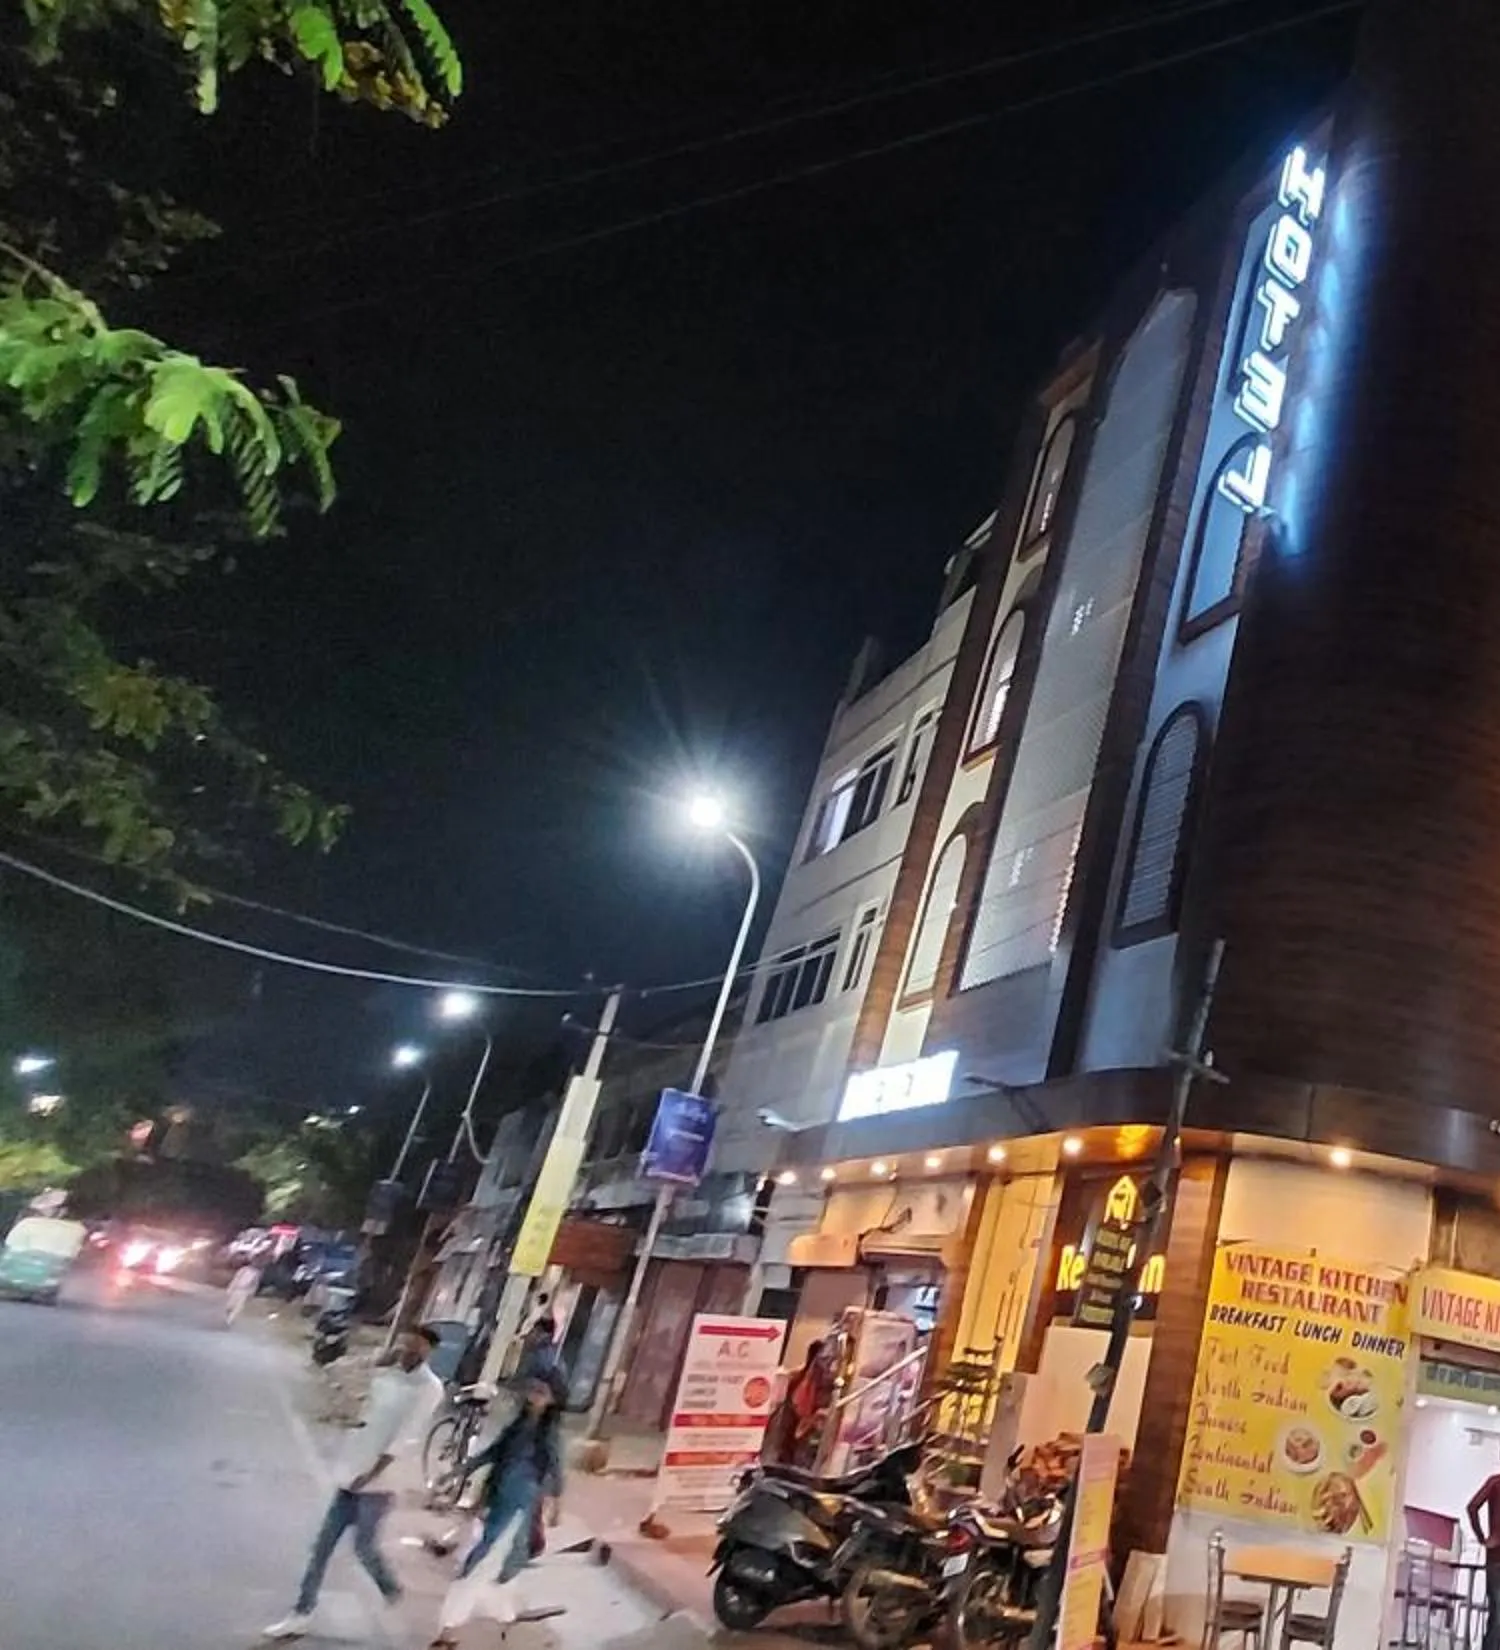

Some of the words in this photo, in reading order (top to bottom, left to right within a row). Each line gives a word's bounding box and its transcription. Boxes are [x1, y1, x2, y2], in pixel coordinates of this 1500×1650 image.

[1225, 1251, 1311, 1285] VINTAGE
[1319, 1267, 1409, 1305] KITCHEN
[1241, 1279, 1384, 1325] RESTAURANT
[1209, 1303, 1287, 1334] BREAKFAST
[1294, 1320, 1343, 1345] LUNCH
[1351, 1331, 1406, 1360] DINNER
[1421, 1286, 1483, 1330] VINTAGE
